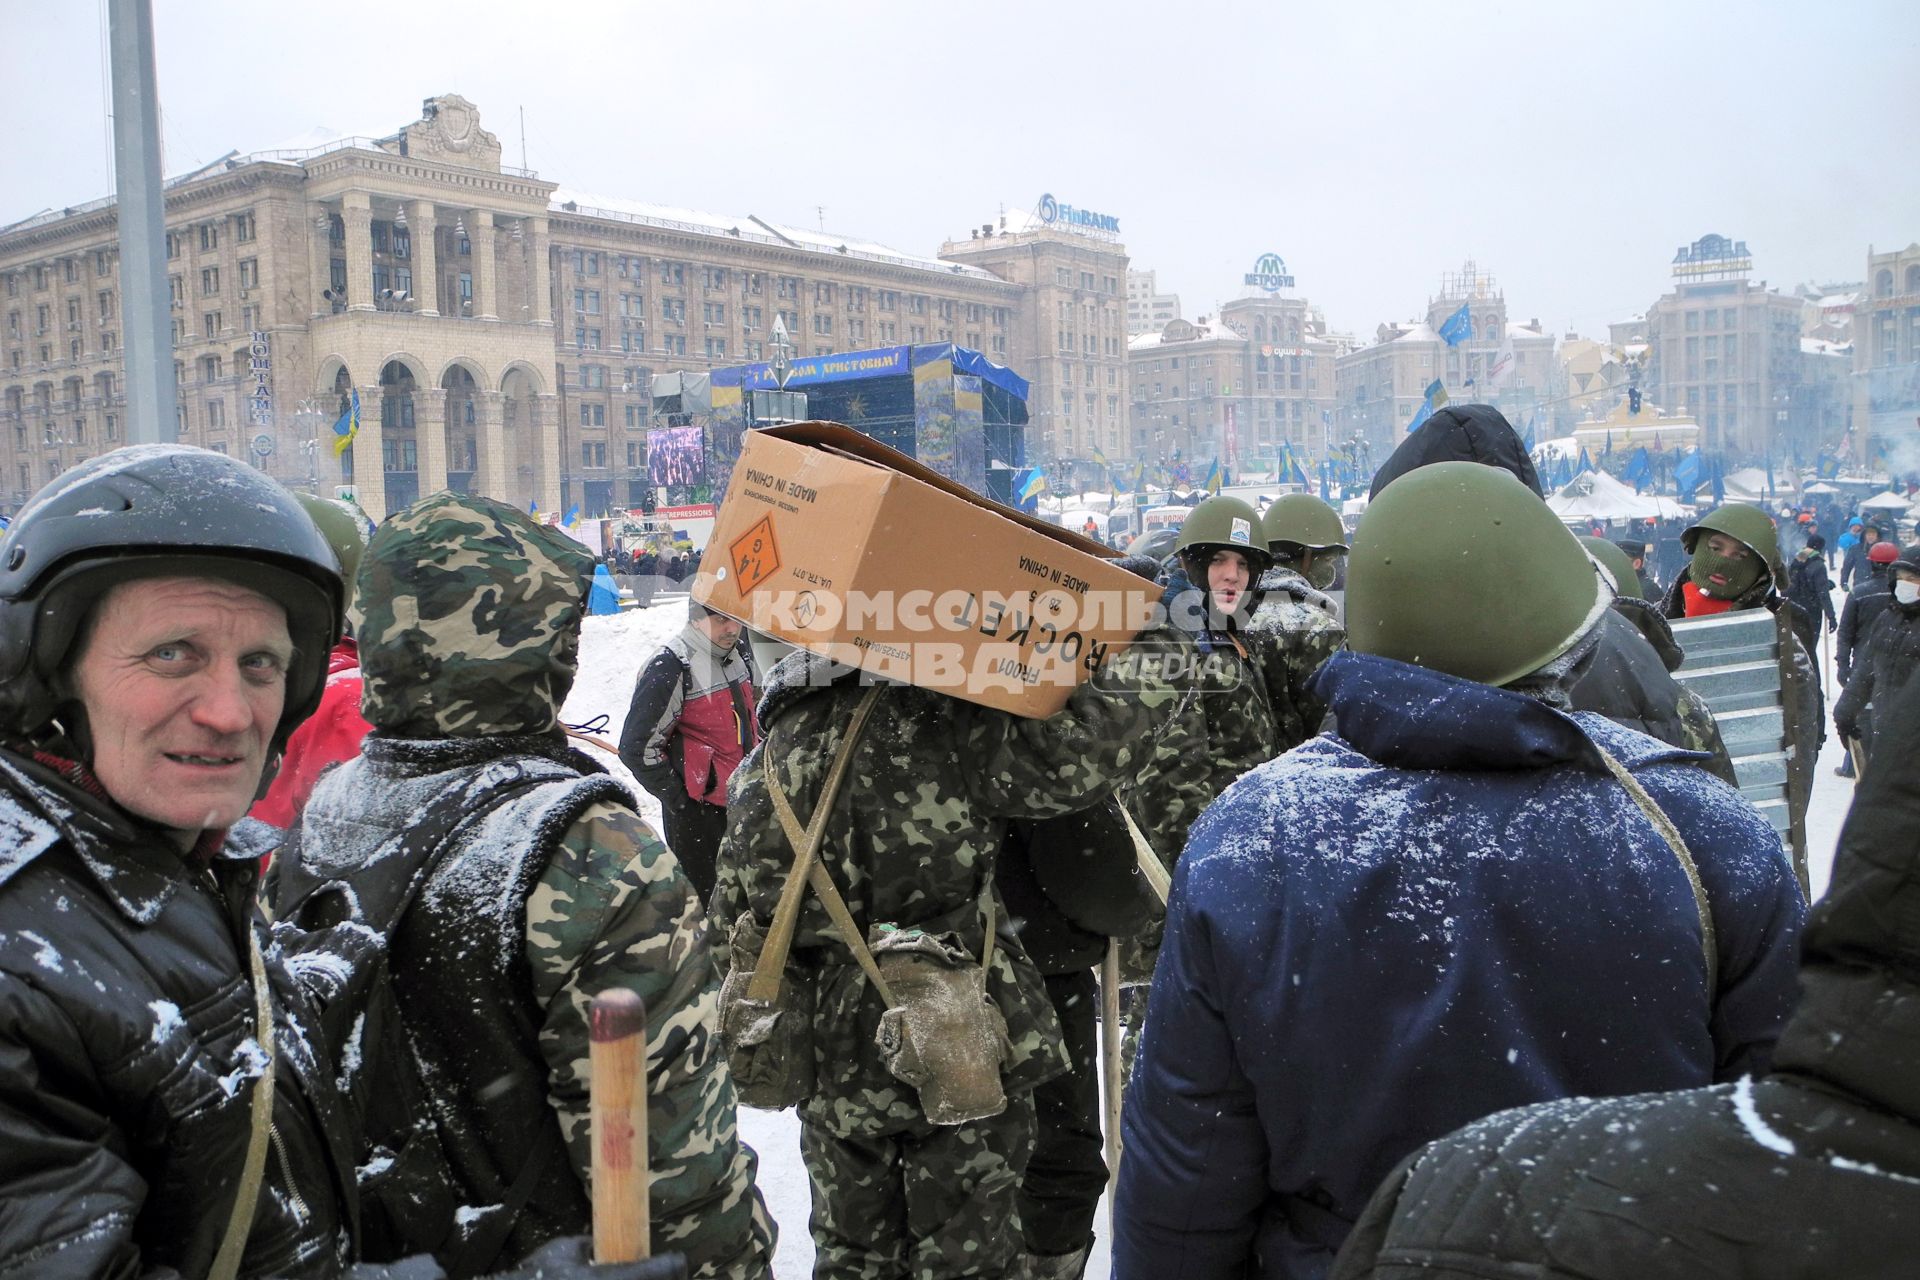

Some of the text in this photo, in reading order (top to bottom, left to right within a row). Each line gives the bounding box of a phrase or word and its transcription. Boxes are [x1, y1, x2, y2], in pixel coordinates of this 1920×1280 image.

[1058, 203, 1121, 233] FinBANK
[1245, 273, 1295, 288] МЕТРОБУД
[252, 331, 271, 425] ПОШТАМТ
[743, 488, 776, 505] FIREWORKS
[746, 468, 817, 503] MADE IN CHINA
[753, 539, 762, 553] G
[739, 554, 761, 580] 1.4
[792, 567, 832, 589] UA.TR.071
[1019, 555, 1091, 595] MADE IN CHINA
[953, 592, 1108, 672] ROCKET
[999, 657, 1040, 684] FR001
